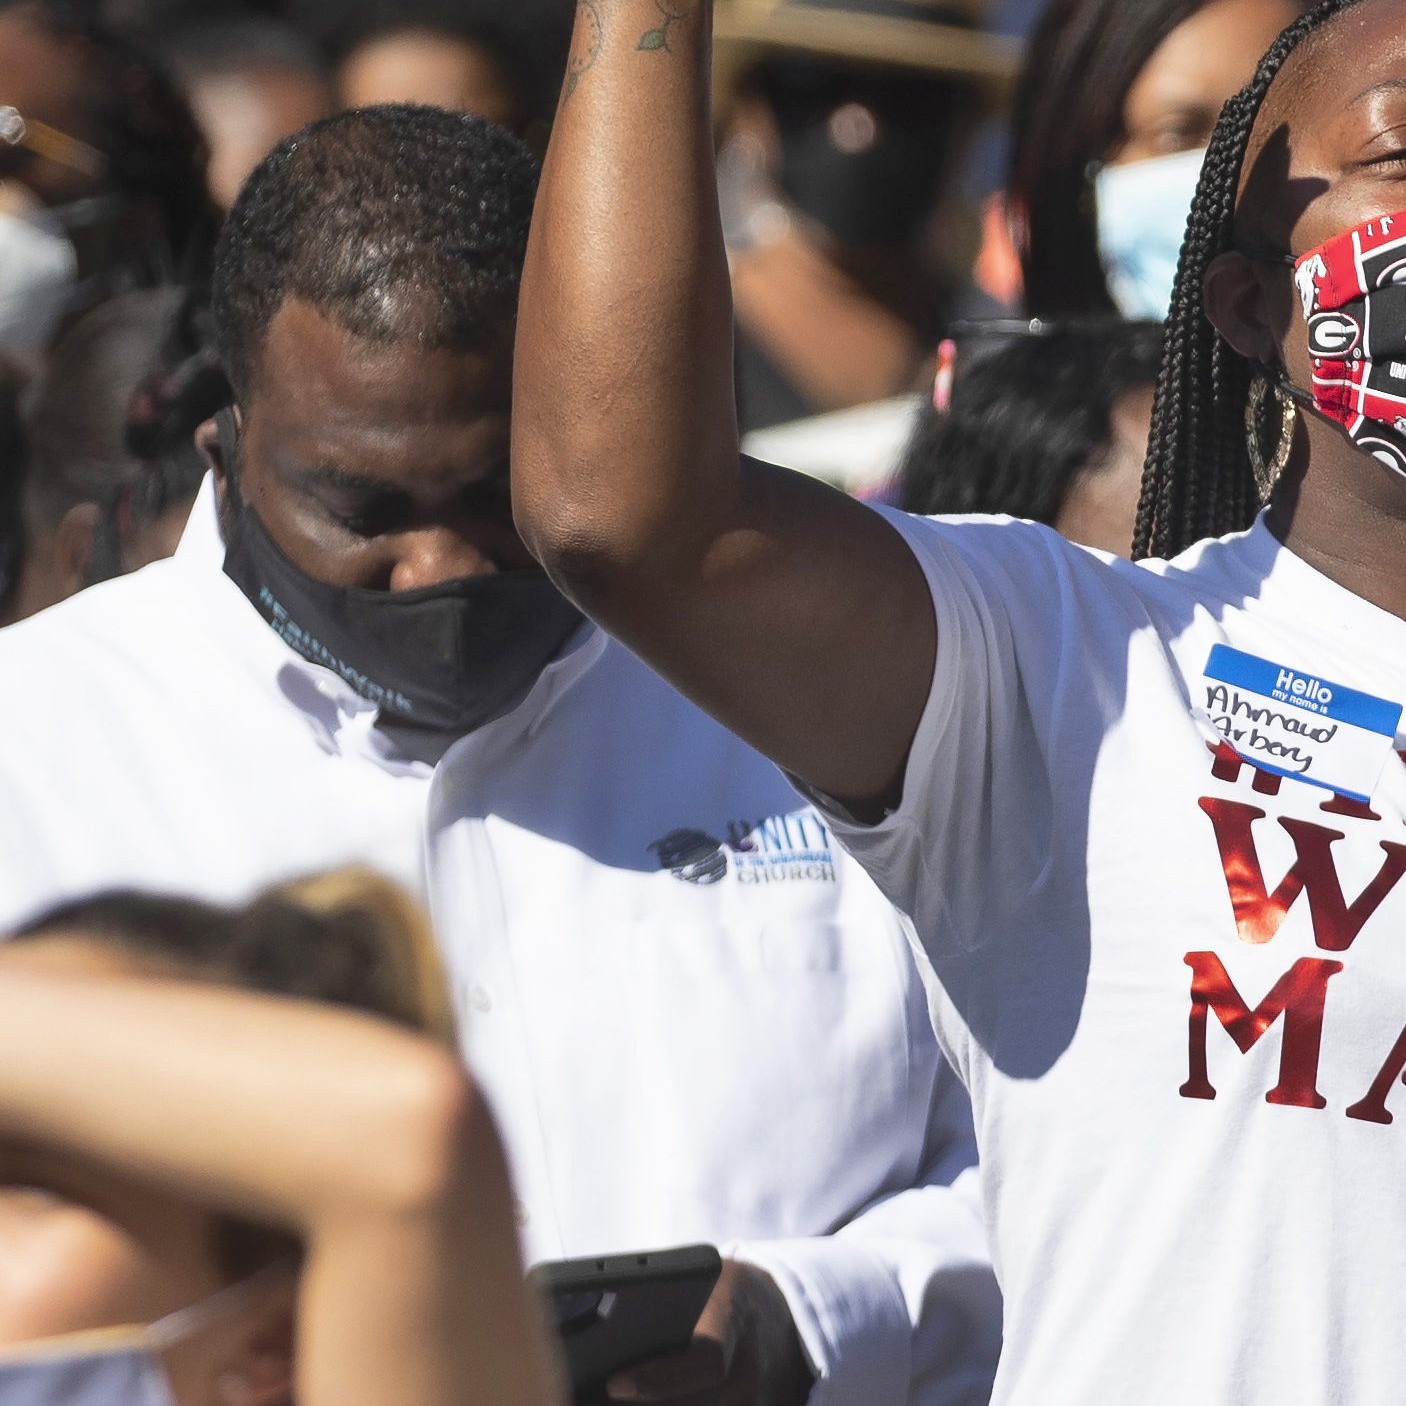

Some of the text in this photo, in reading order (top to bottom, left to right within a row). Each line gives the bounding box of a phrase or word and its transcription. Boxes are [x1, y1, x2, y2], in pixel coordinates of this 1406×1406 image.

[1275, 669, 1333, 703] Hello
[1206, 685, 1338, 743] Ahmaud
[1272, 689, 1328, 715] my name is
[738, 863, 836, 883] CHURCH
